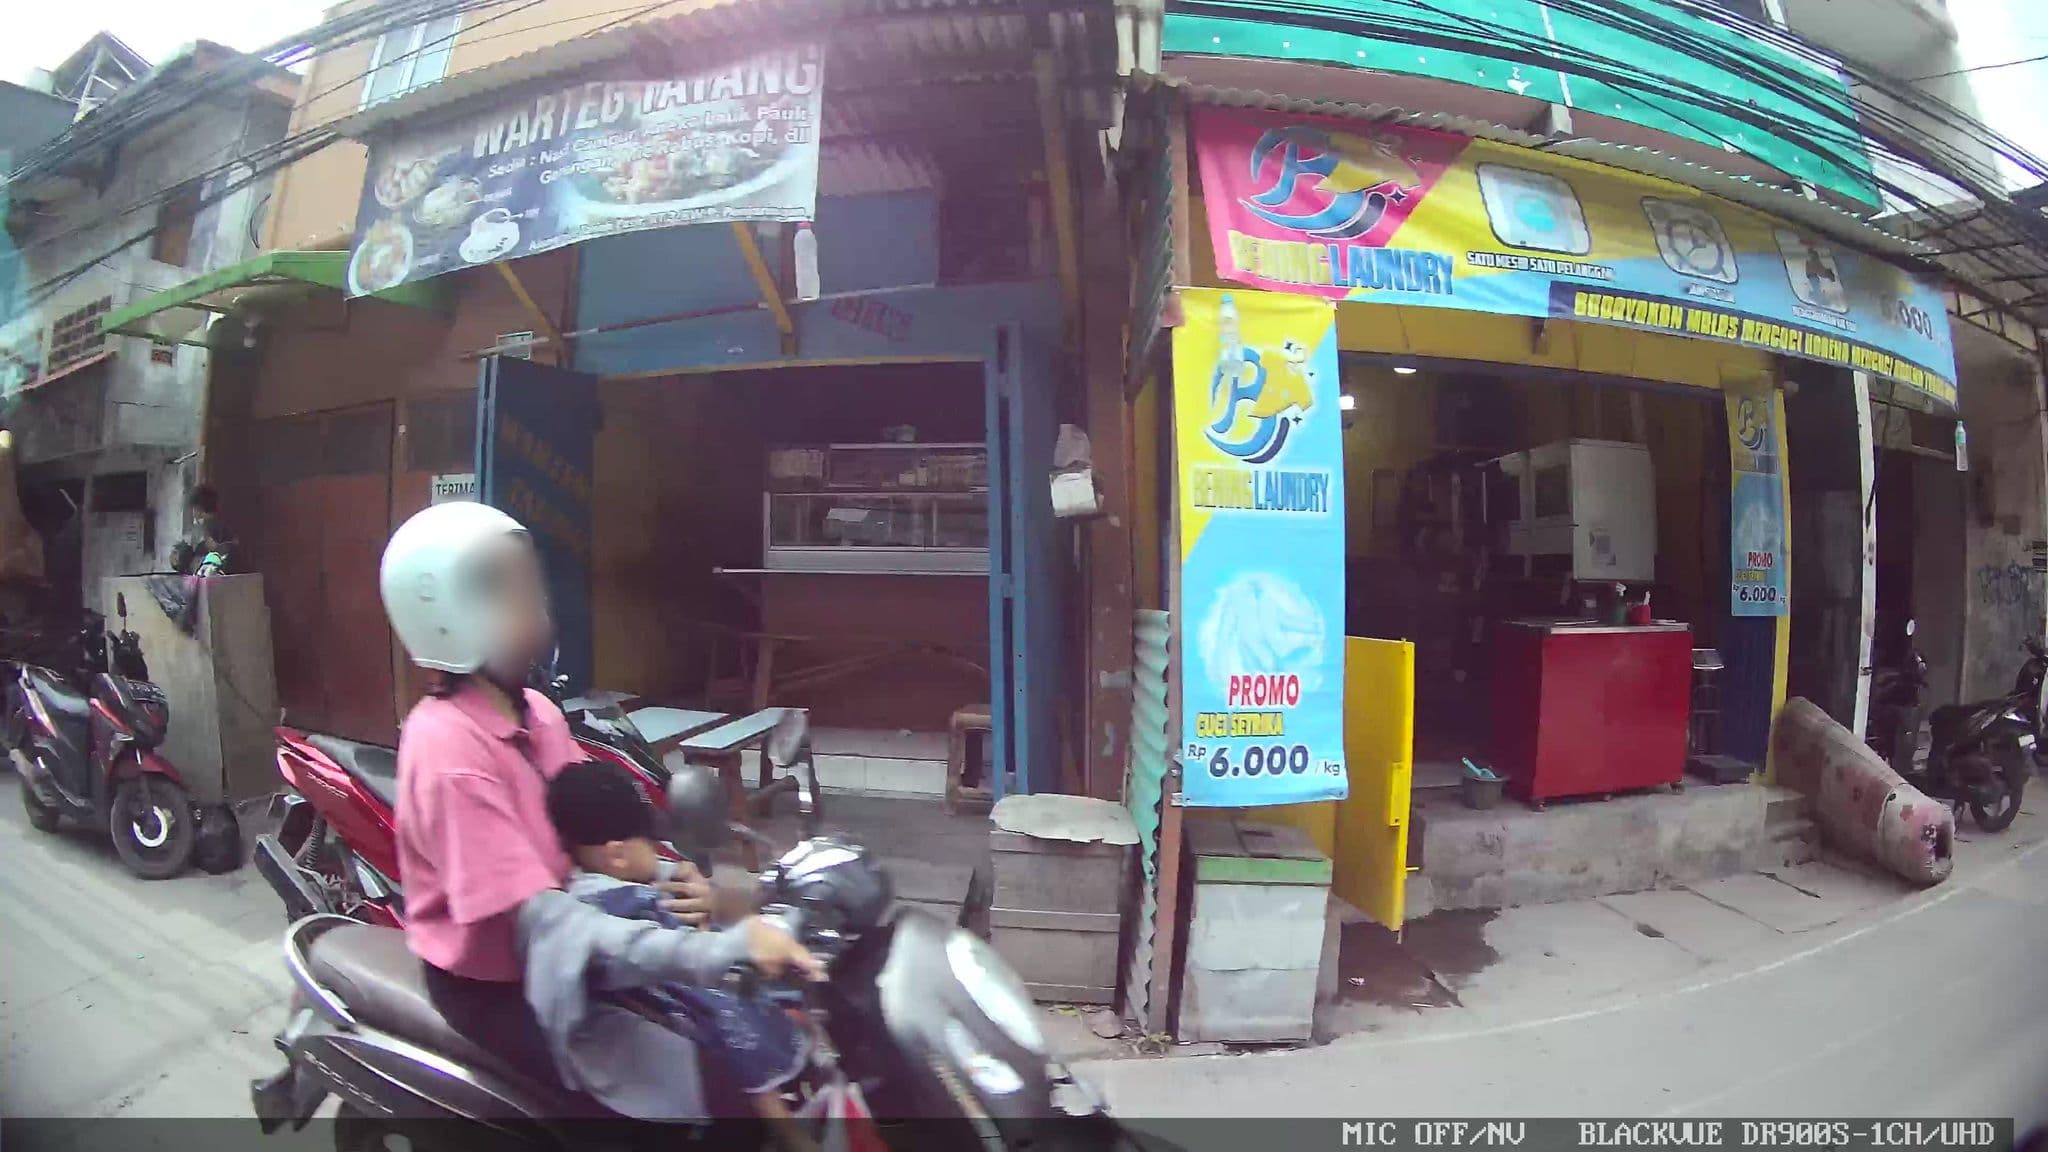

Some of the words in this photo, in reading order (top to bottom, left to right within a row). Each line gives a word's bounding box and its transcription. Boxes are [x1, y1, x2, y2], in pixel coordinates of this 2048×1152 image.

[1328, 244, 1454, 295] LAUNDRY
[1254, 470, 1329, 513] LAUNDRY
[1229, 674, 1300, 706] PROMO
[1187, 744, 1207, 760] Rp
[1209, 745, 1309, 777] 6.000
